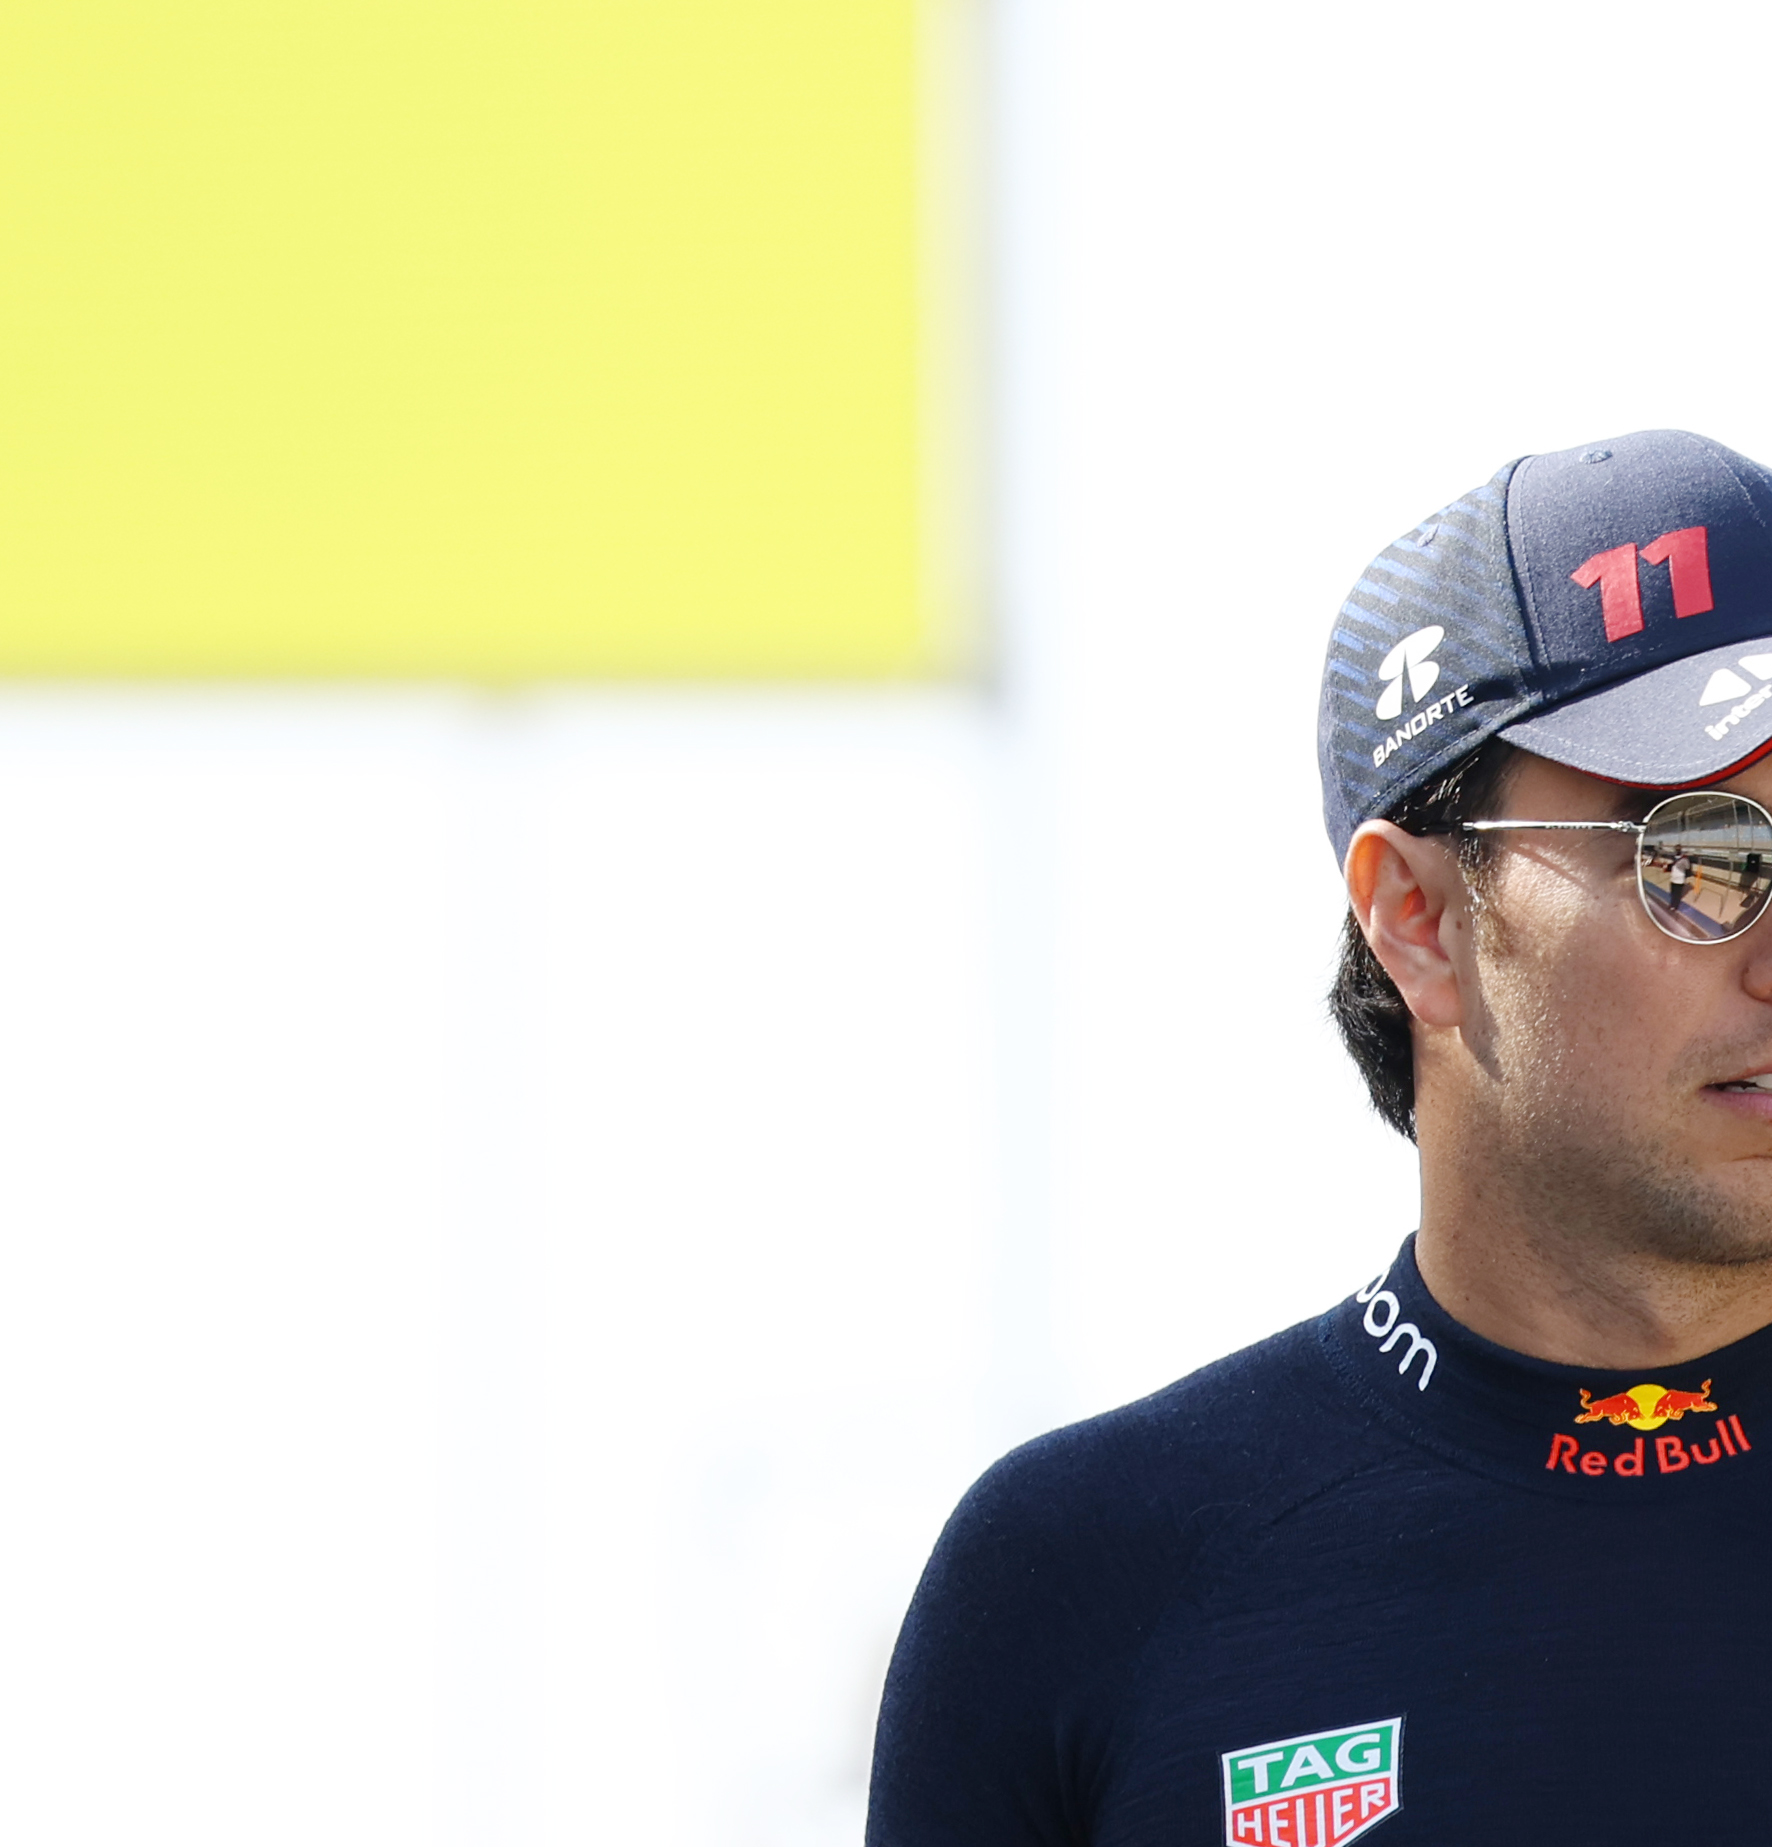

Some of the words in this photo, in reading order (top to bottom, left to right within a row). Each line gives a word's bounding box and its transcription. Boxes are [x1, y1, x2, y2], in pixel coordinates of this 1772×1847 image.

[1570, 526, 1715, 643] 11
[1372, 683, 1474, 769] BANORTE
[1545, 1434, 1644, 1477] Red
[1655, 1414, 1753, 1476] Bull
[1240, 1731, 1383, 1791] TAG
